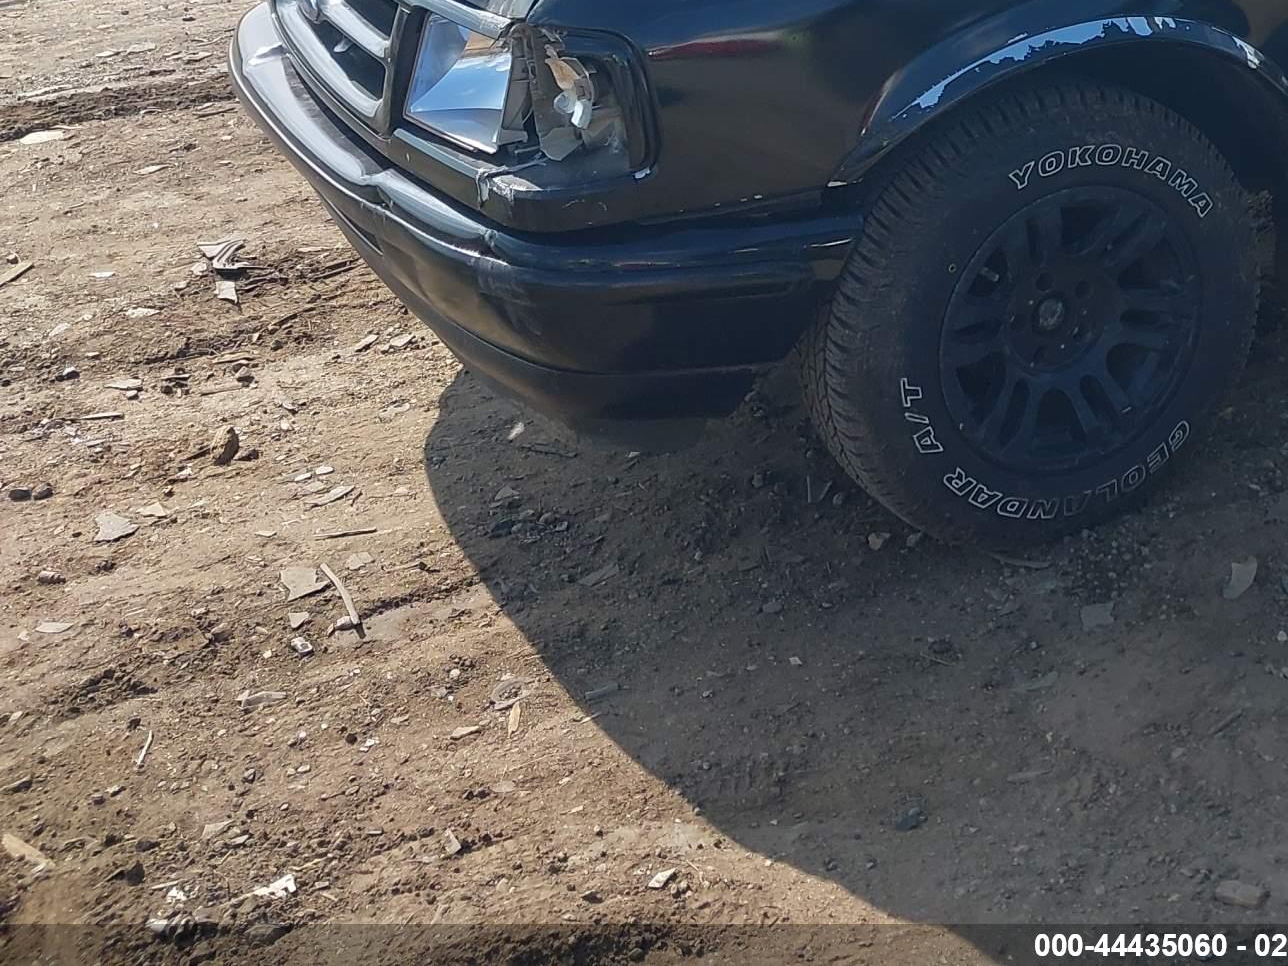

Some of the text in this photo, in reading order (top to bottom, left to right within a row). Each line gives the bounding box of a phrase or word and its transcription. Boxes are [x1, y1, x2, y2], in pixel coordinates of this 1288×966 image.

[1009, 144, 1214, 218] YOKOHAMA
[900, 377, 1190, 519] GEOLANDAR A/T
